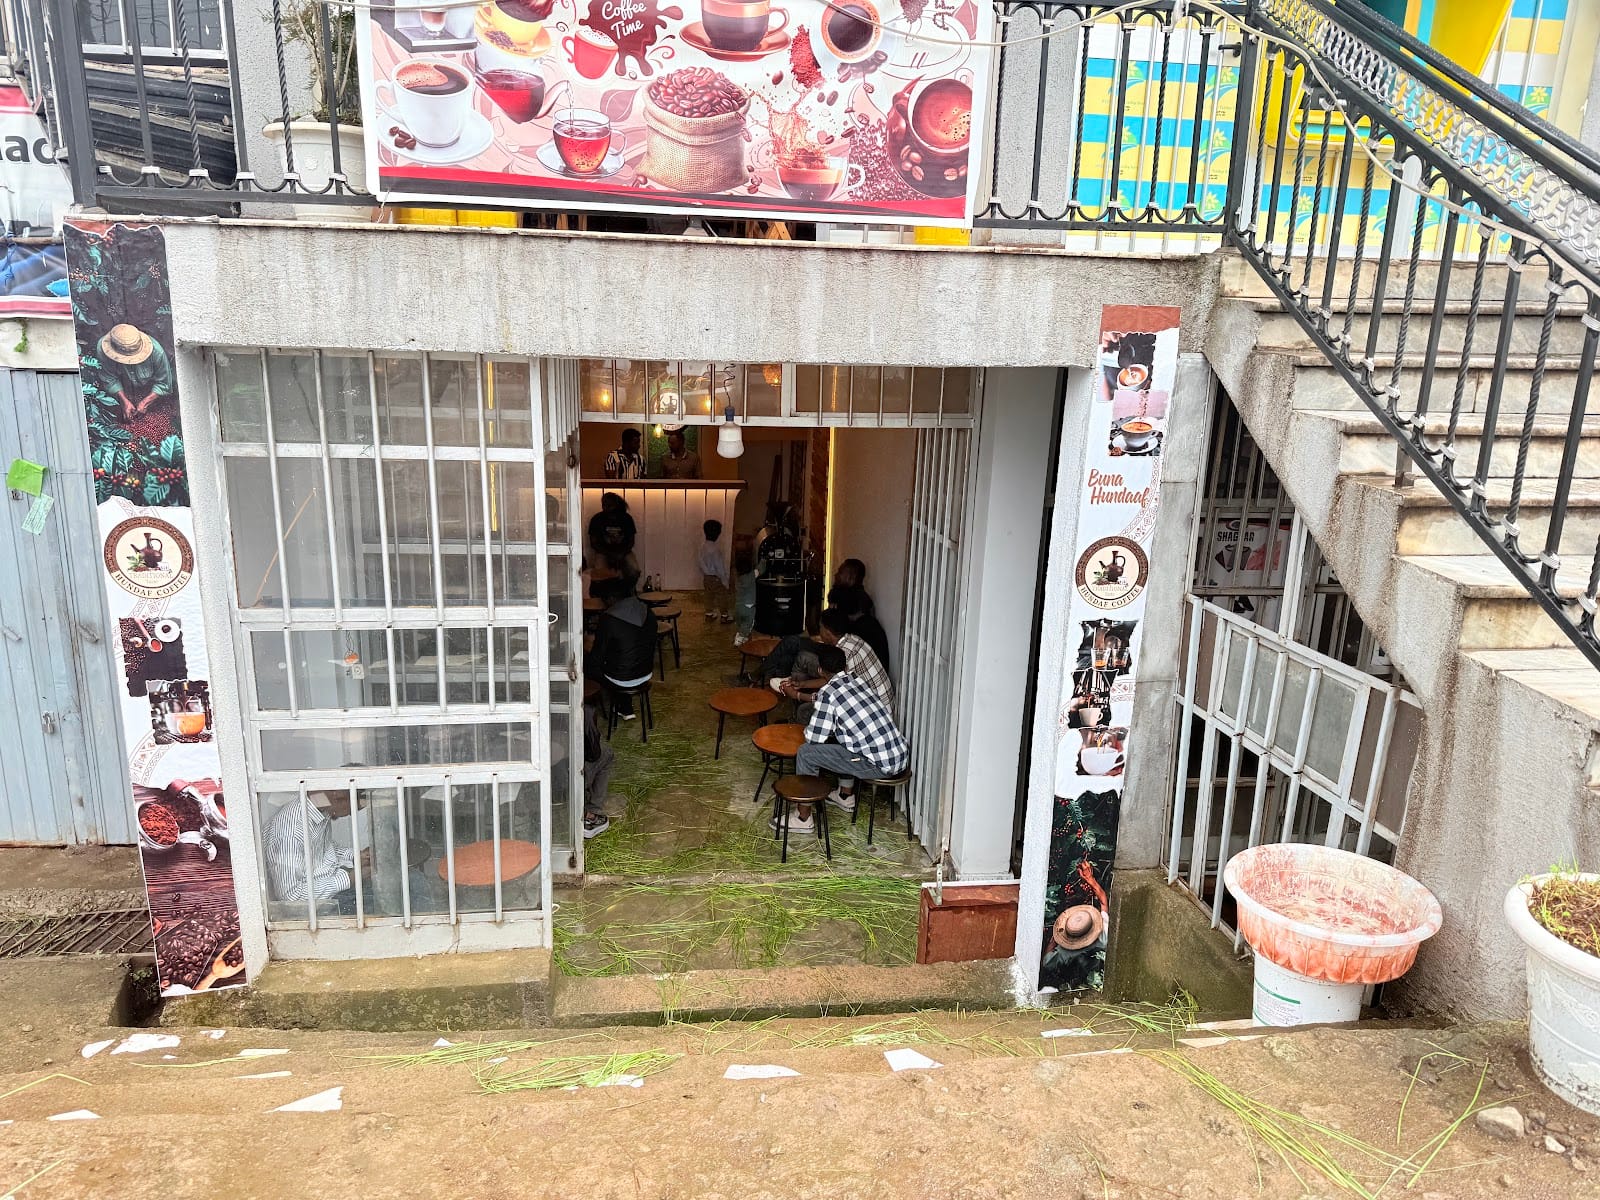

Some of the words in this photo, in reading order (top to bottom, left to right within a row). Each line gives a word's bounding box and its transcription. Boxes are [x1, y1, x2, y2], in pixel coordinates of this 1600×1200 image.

[602, 0, 647, 20] Coffee
[611, 20, 645, 40] Time
[1087, 468, 1124, 487] Buna
[1090, 486, 1150, 508] Hundaaf
[1217, 531, 1255, 542] SHAGAR
[115, 573, 153, 597] HUNDAF
[156, 573, 188, 597] COFFEE
[1080, 586, 1109, 608] HUNDAF
[1111, 587, 1140, 608] COFFEE
